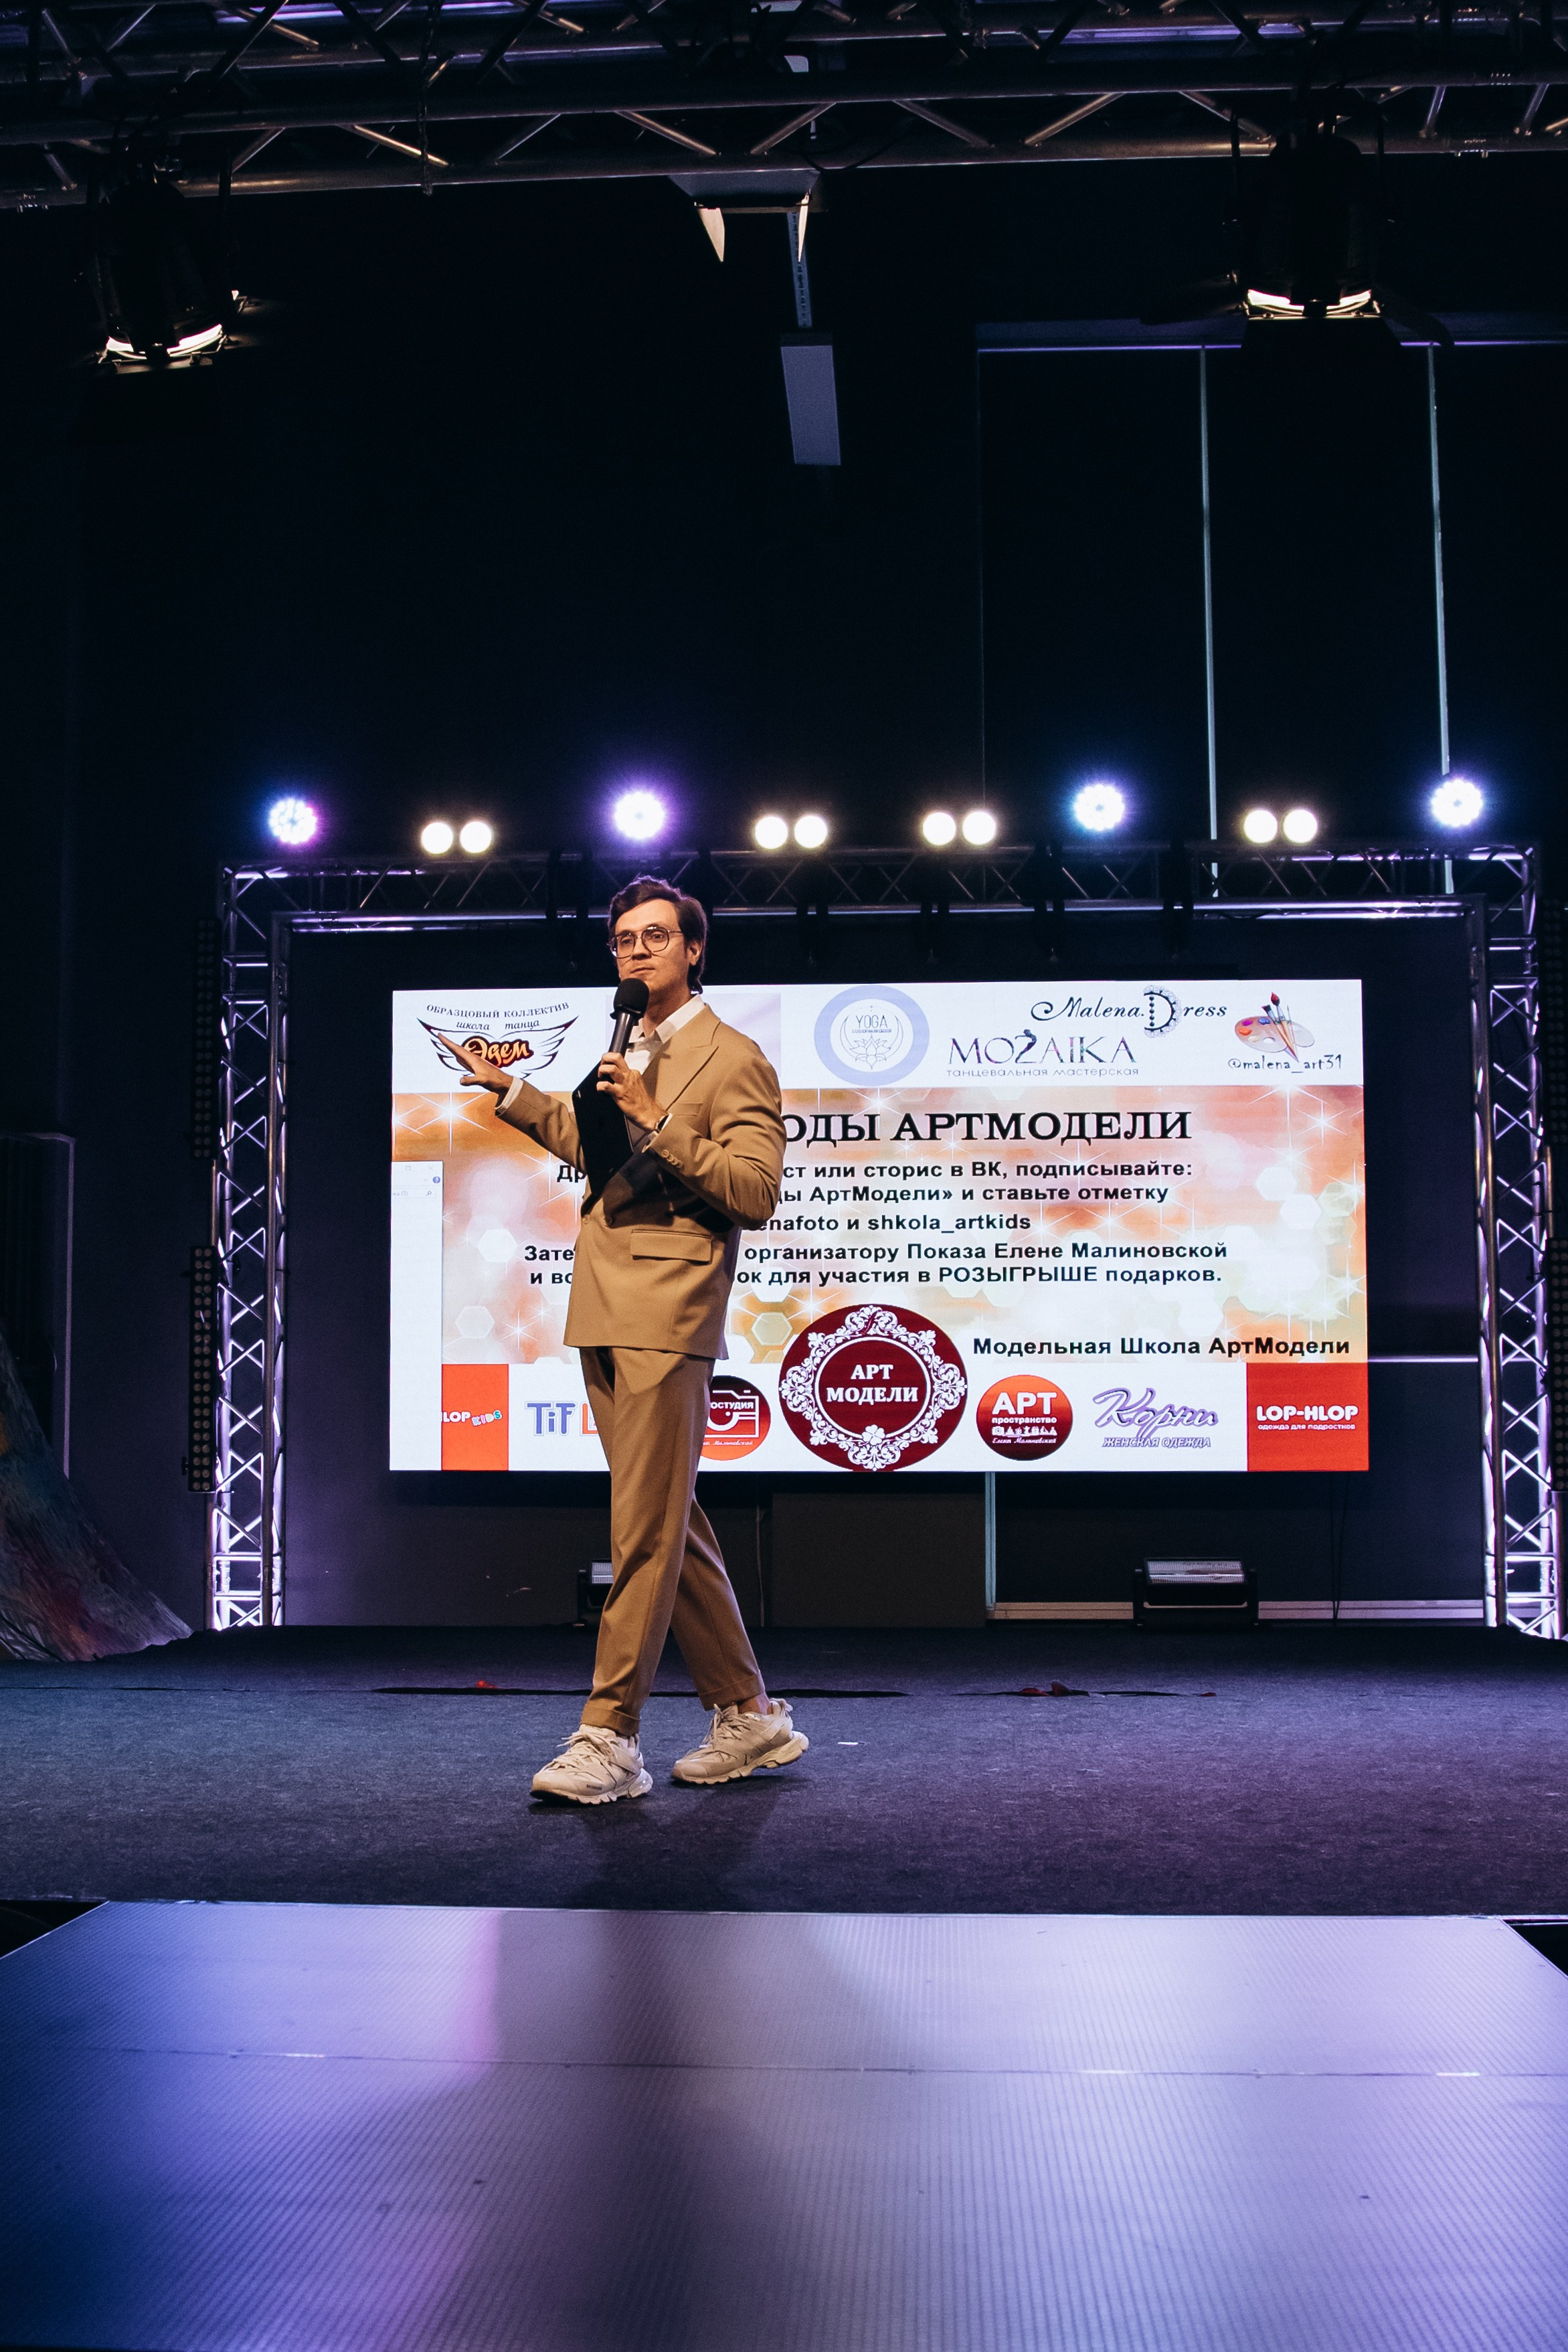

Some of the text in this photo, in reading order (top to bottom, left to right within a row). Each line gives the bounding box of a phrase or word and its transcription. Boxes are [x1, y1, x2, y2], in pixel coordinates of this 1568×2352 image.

[426, 1002, 570, 1018] ОБРАЗЦОВЫЙ КОЛЛЕКТИВ
[456, 1020, 540, 1031] школа танца
[855, 1015, 887, 1029] YOGA
[464, 1038, 529, 1066] Эдем
[948, 1029, 1138, 1064] MOZAIKA
[946, 1069, 1139, 1078] танцевальная мастерская
[782, 1112, 1191, 1149] ОДЫ АРТМОДЕЛИ
[783, 1161, 1193, 1181] ст или сторис в ВК, подписывайте:
[810, 1186, 953, 1203] АртМодели»
[962, 1188, 974, 1199] и
[982, 1187, 1071, 1201] ставьте
[1078, 1187, 1168, 1203] отметку
[847, 1218, 860, 1230] и
[867, 1214, 1031, 1234] shkola_artkids
[524, 1246, 574, 1261] Зате
[744, 1242, 1227, 1263] организатору Показа Елене Малиновской
[530, 1272, 543, 1284] и
[769, 1271, 811, 1286] для
[818, 1270, 909, 1286] участия
[919, 1270, 931, 1282] в
[939, 1266, 1098, 1282] РОЗЫГРЫШЕ
[1106, 1270, 1223, 1284] подарков.
[974, 1337, 1349, 1357] Модельная Школа АртМодели
[851, 1364, 894, 1379] АРТ
[826, 1387, 919, 1405] МОДЕЛИ
[992, 1392, 1057, 1414] АРТ
[711, 1402, 754, 1410] ОСТУДИЯ
[1093, 1388, 1219, 1439] Корни
[1256, 1405, 1359, 1422] LOP-HLOP
[442, 1410, 503, 1426] LOP KIDS
[992, 1416, 1057, 1425] пространство
[1102, 1437, 1211, 1448] ЖЕНСКАЯ ОДЕЖДА
